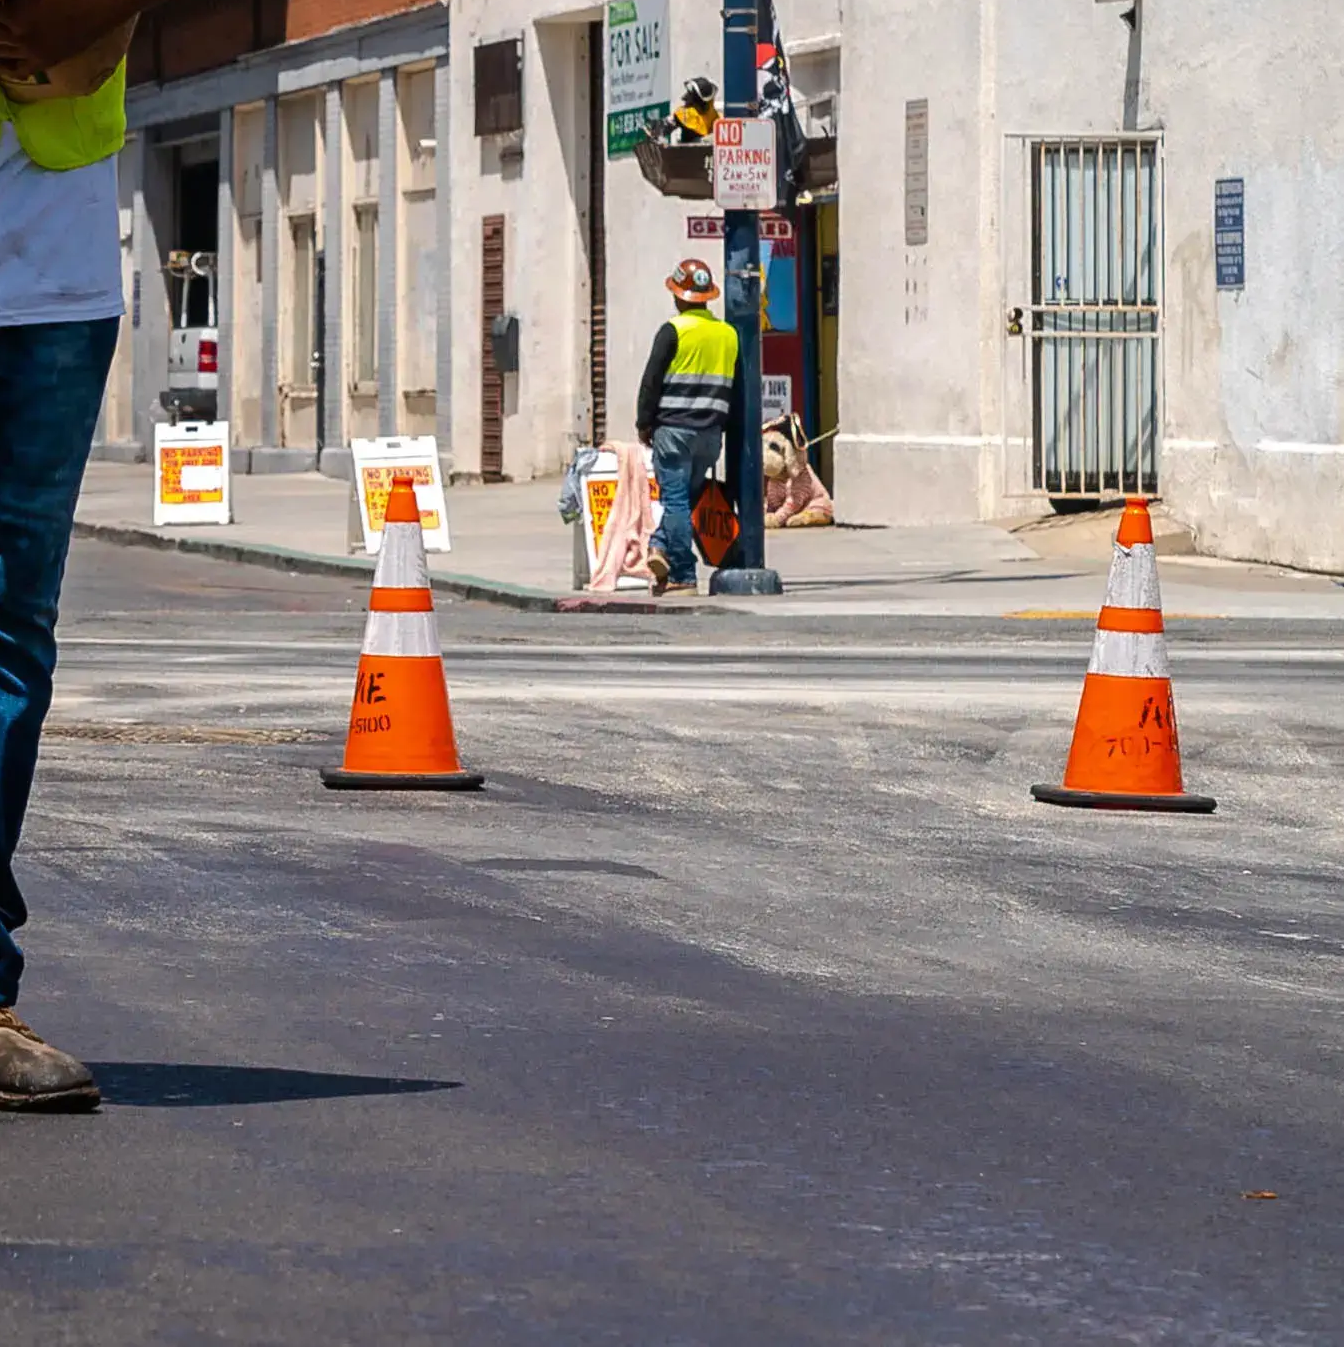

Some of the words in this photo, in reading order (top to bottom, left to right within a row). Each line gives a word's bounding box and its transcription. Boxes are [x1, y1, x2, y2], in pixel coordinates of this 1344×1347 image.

[610, 28, 632, 67] FOR
[634, 20, 661, 64] SALE
[718, 123, 740, 143] NO
[718, 149, 771, 165] PARKING
